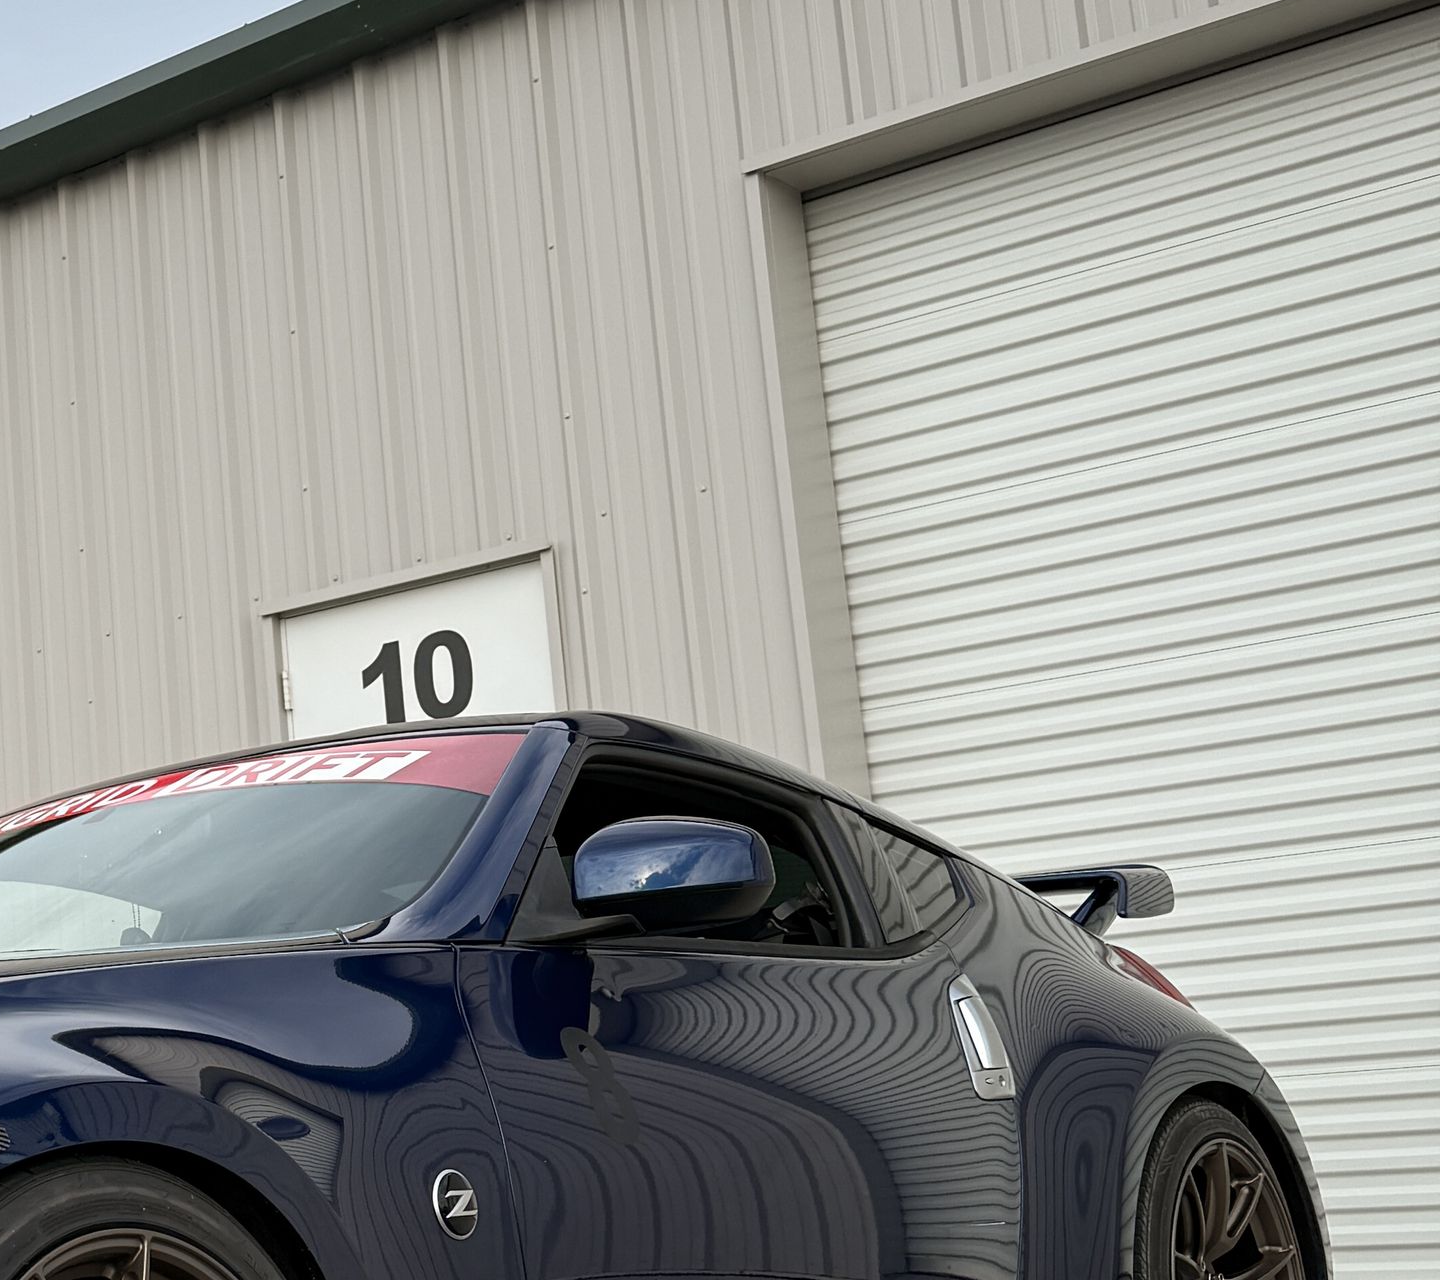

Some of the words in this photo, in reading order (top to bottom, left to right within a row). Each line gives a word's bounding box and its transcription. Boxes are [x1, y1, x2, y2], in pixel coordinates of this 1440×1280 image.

[361, 629, 474, 723] 10
[169, 752, 412, 793] DRIFT
[444, 1189, 478, 1219] Z
